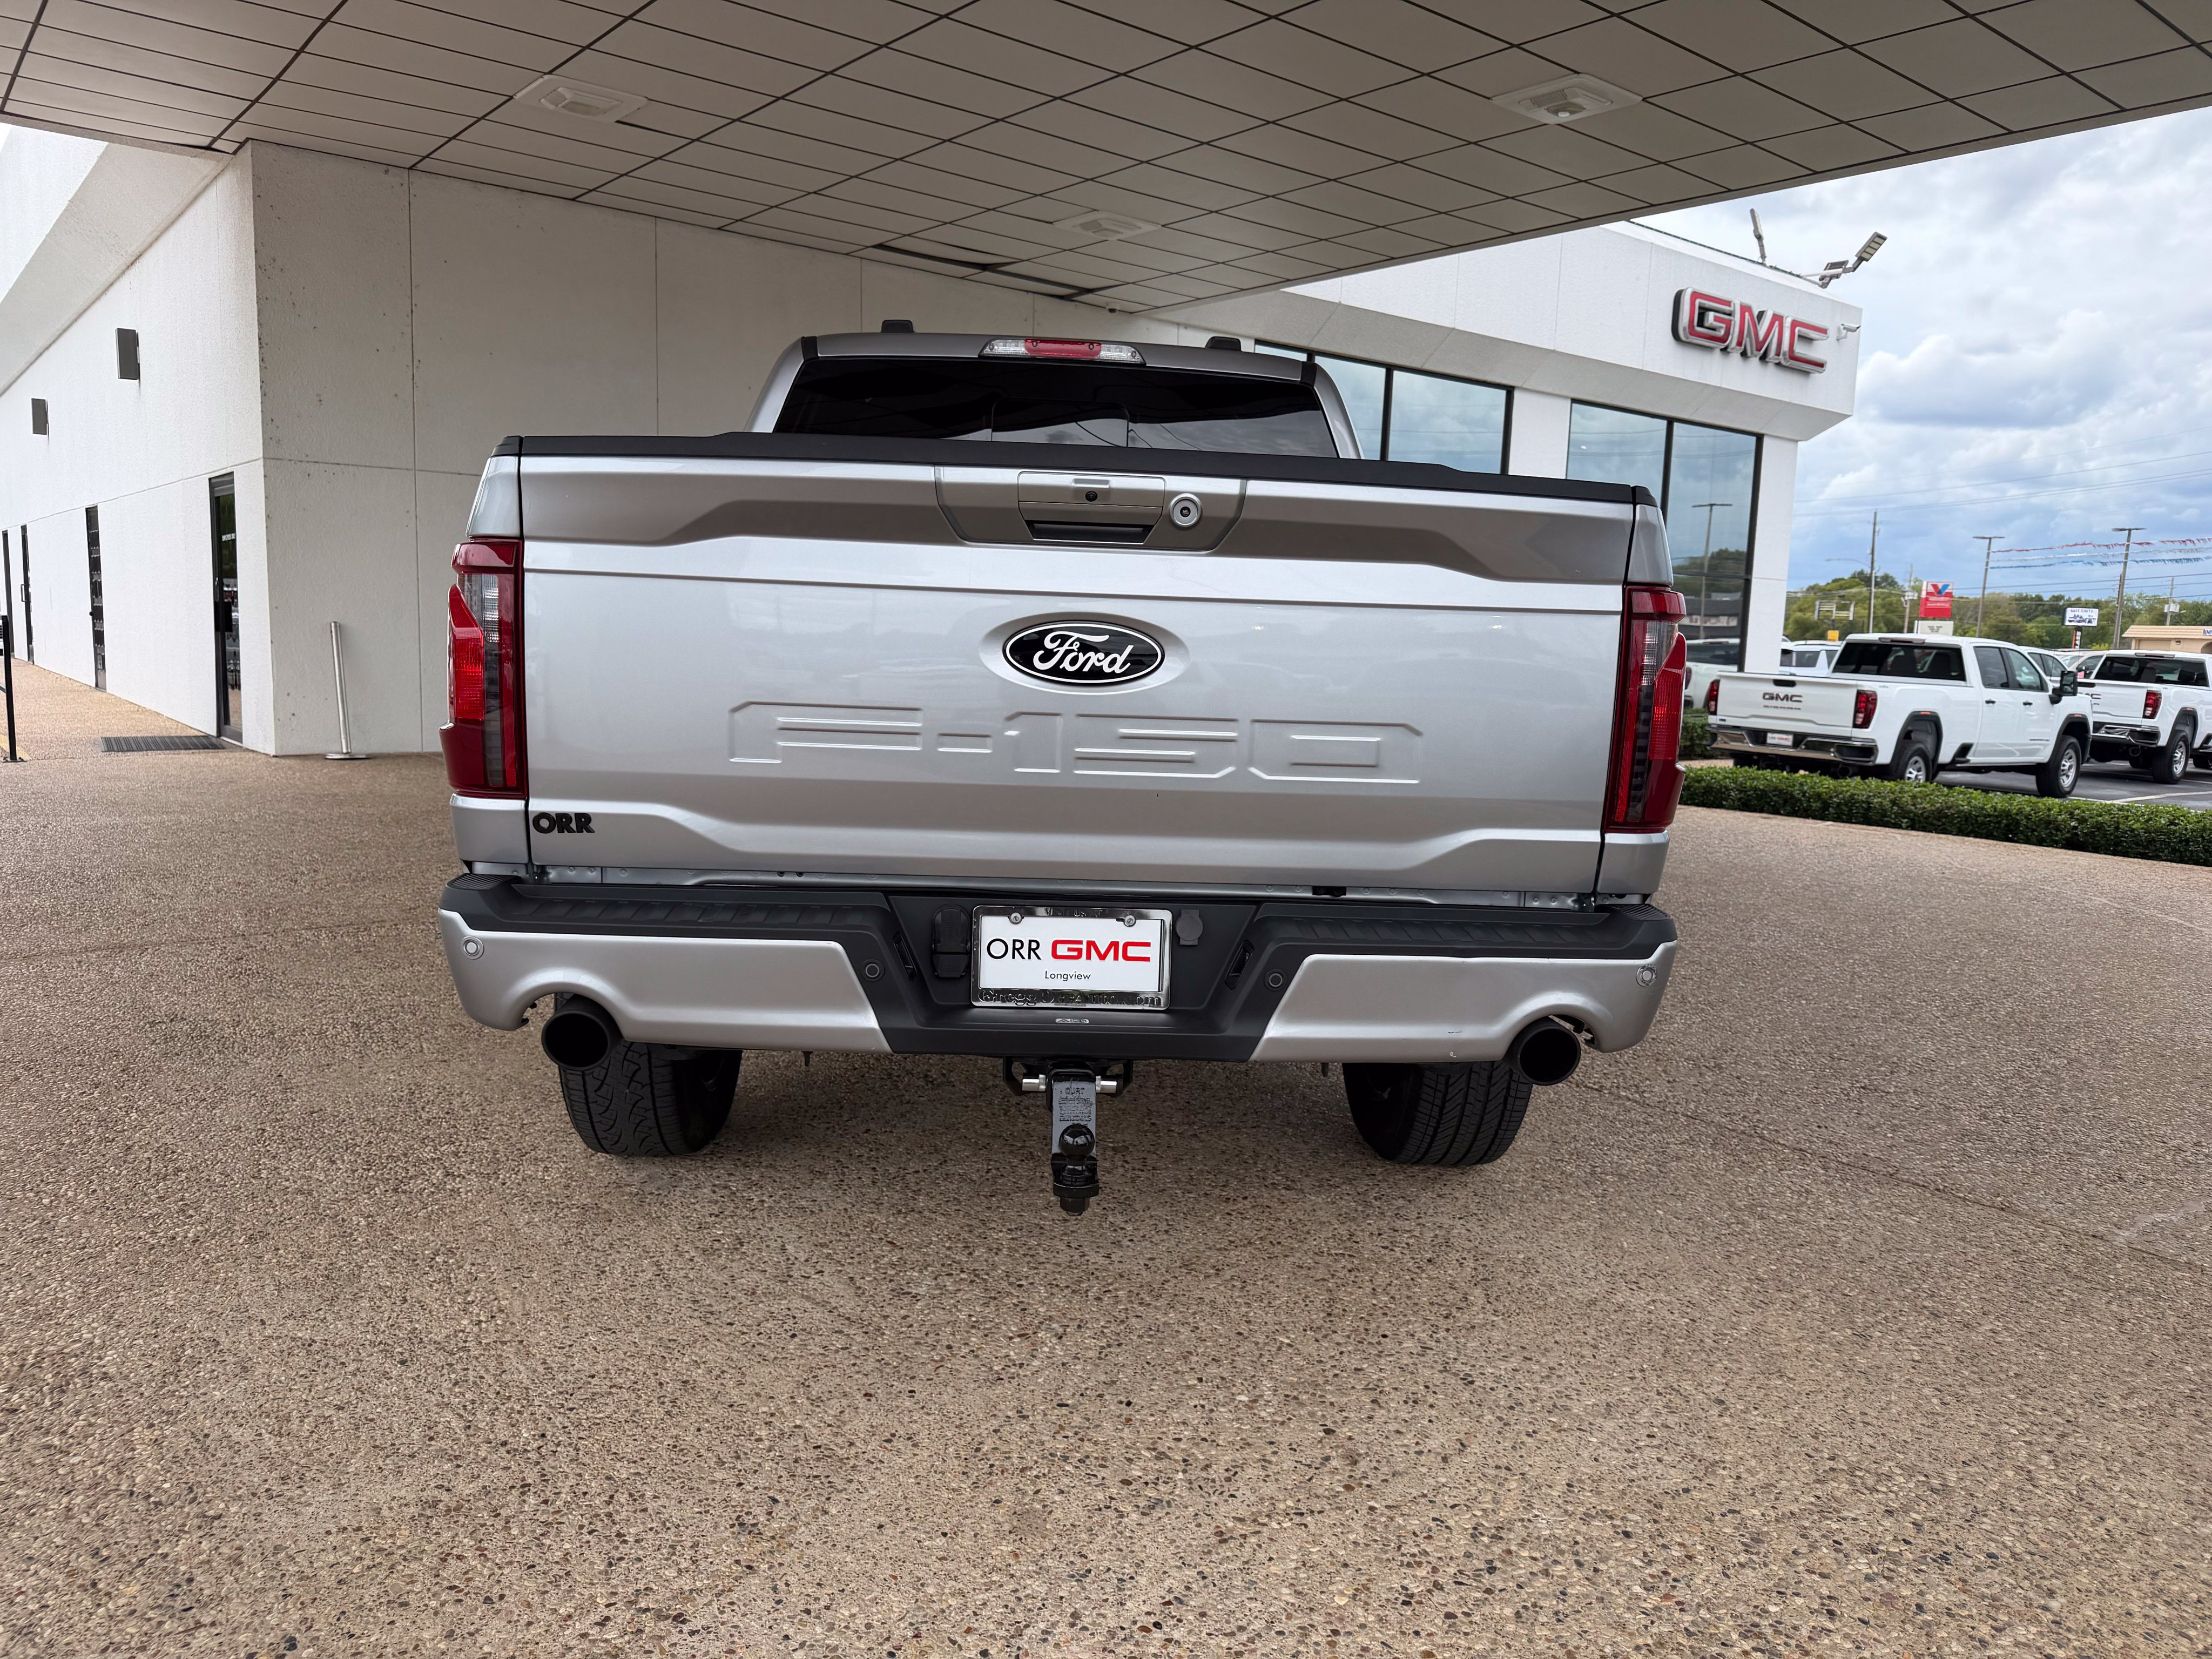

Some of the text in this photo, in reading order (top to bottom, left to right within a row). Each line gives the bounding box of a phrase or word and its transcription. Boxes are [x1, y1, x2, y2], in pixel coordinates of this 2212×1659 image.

[1671, 287, 1830, 374] GMC
[1033, 631, 1134, 674] Ford
[1763, 692, 1803, 703] GMC
[729, 701, 1423, 785] F-150
[532, 812, 595, 834] ORR
[987, 938, 1151, 962] ORR GMC
[1045, 970, 1091, 981] Longview
